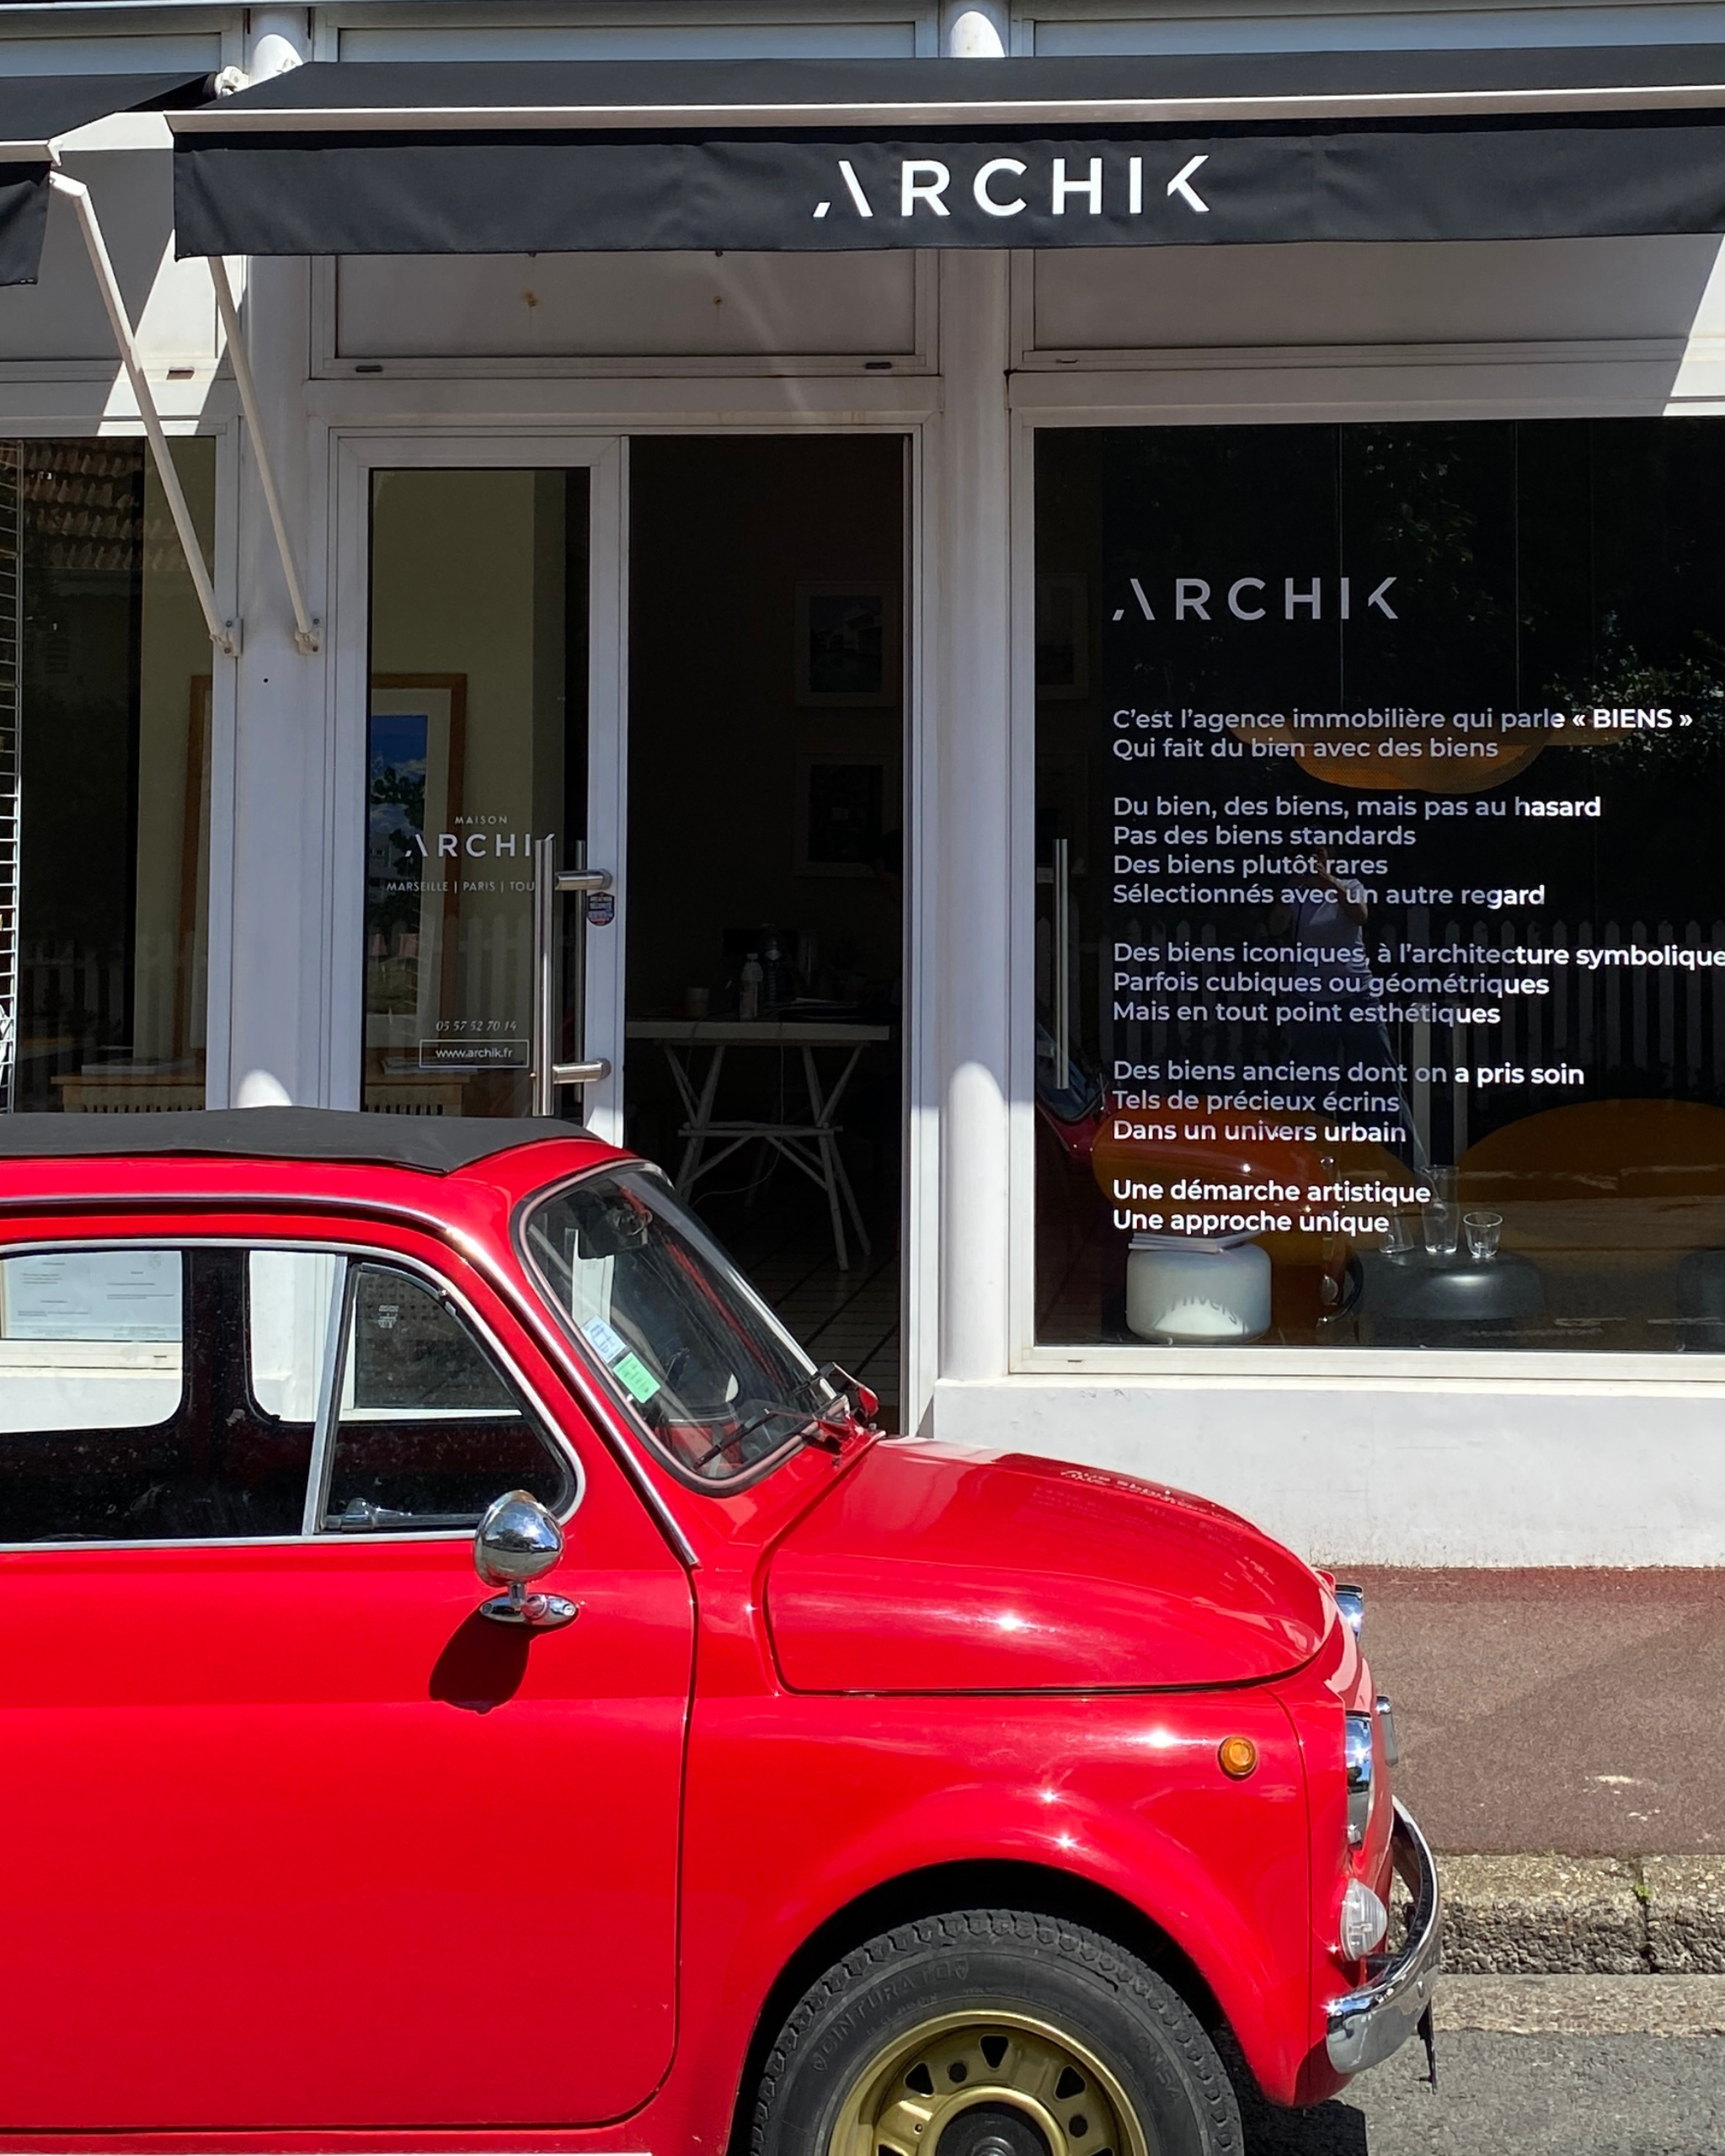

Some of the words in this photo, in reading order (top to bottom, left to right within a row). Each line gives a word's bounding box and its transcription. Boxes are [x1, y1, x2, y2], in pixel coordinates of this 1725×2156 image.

[813, 155, 1210, 218] ARCHIK
[1112, 577, 1399, 620] ARCHIK
[1113, 708, 1173, 728] C’est
[1181, 708, 1285, 733] l’agence
[1292, 707, 1446, 728] immobilière
[1452, 707, 1493, 733] qui
[1501, 707, 1566, 733] parle
[1593, 708, 1673, 728] BIENS
[1113, 737, 1156, 761] Qui
[1162, 737, 1204, 758] fait
[1210, 737, 1242, 757] du
[1251, 737, 1306, 757] bien
[1313, 742, 1370, 757] avec
[1377, 737, 1423, 757] des
[1430, 736, 1498, 758] biens
[455, 816, 508, 825] MAISON
[1114, 797, 1148, 816] Du
[1156, 795, 1217, 819] bien,
[1224, 796, 1268, 816] des
[1276, 795, 1349, 819] biens,
[1357, 795, 1418, 816] mais
[1424, 801, 1469, 821] pas
[1475, 801, 1506, 816] au
[1515, 796, 1601, 817] hasard
[404, 833, 555, 857] ARCHI
[1114, 825, 1157, 845] Pas
[1163, 825, 1209, 845] des
[1215, 824, 1284, 845] biens
[1290, 825, 1417, 846] standards
[1114, 855, 1161, 874] Des
[1167, 853, 1236, 874] biens
[1242, 854, 1319, 879] plutôt
[1326, 859, 1388, 874] rares
[387, 882, 449, 892] MARSEILLE
[462, 881, 496, 892] PARIS
[509, 881, 535, 892] TOU
[1113, 882, 1274, 904] Sélectionnés
[1280, 888, 1338, 905] avec
[1345, 889, 1379, 905] un
[1386, 886, 1454, 905] autre
[1461, 884, 1545, 910] regard
[1114, 942, 1161, 962] Des
[1167, 941, 1236, 963] biens
[1242, 941, 1370, 969] iconiques,
[1377, 942, 1391, 963] à
[1400, 943, 1570, 965] l’architecture
[1576, 944, 1725, 970] symbolique
[1114, 970, 1199, 991] Parfois
[1205, 971, 1322, 997] cubiques
[1328, 976, 1361, 993] ou
[1369, 973, 1550, 999] géométriques
[435, 1021, 450, 1032] 05
[453, 1021, 467, 1032] 57
[470, 1021, 483, 1032] 52
[486, 1021, 501, 1032] 70
[504, 1021, 516, 1032] 14
[1114, 1000, 1171, 1021] Mais
[1177, 1006, 1208, 1022] en
[1215, 1003, 1268, 1022] tout
[1276, 1001, 1343, 1027] point
[1349, 1002, 1501, 1027] esthétiques
[435, 1048, 513, 1058] www.archik.fr
[1114, 1060, 1161, 1081] Des
[1167, 1059, 1236, 1081] biens
[1242, 1059, 1341, 1081] anciens
[1347, 1061, 1408, 1082] dont
[1414, 1067, 1447, 1083] on
[1454, 1067, 1470, 1083] a
[1477, 1061, 1525, 1088] pris
[1530, 1062, 1584, 1085] soin
[1112, 1089, 1161, 1110] Tels
[1167, 1089, 1199, 1110] de
[1207, 1089, 1316, 1115] précieux
[1322, 1091, 1401, 1113] écrins
[1114, 1120, 1178, 1140] Dans
[1184, 1124, 1216, 1140] un
[1225, 1119, 1317, 1141] univers
[1324, 1121, 1407, 1143] urbain
[1114, 1179, 1164, 1200] Une
[1170, 1178, 1300, 1202] démarche
[1307, 1180, 1431, 1208] artistique
[1113, 1209, 1164, 1230] Une
[1170, 1209, 1292, 1235] approche
[1299, 1213, 1390, 1237] unique
